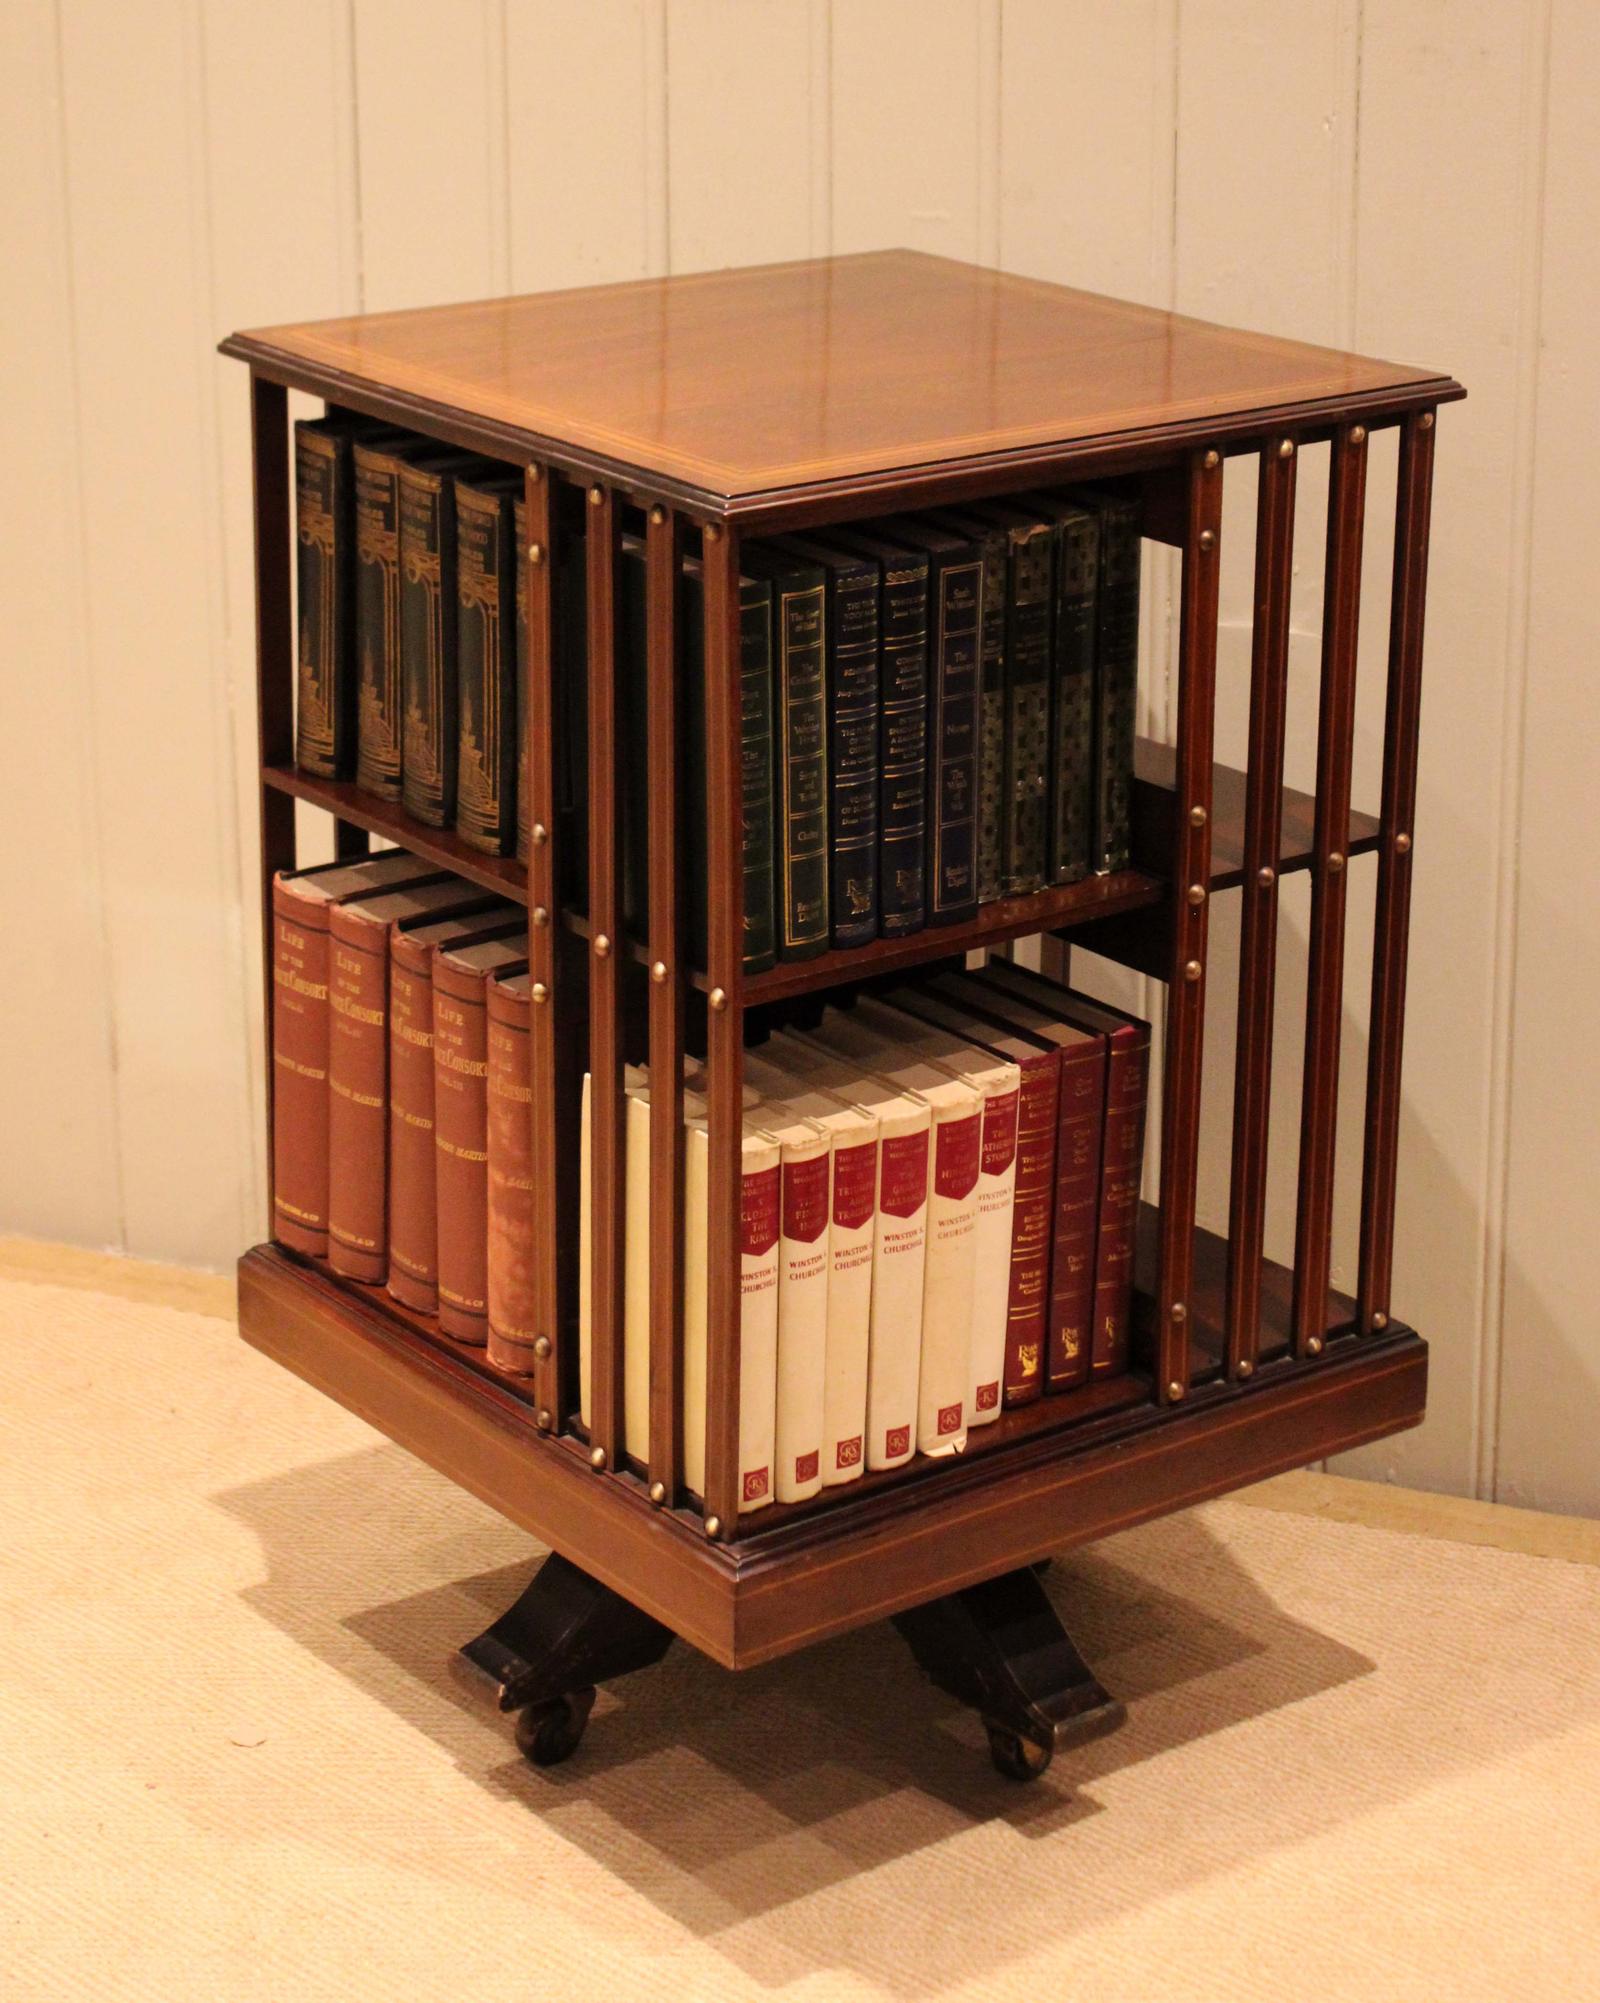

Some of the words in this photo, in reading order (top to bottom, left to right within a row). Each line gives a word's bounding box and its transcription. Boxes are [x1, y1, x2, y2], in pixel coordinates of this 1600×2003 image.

[281, 926, 305, 950] LIFE
[337, 951, 362, 976] LIFE
[289, 970, 328, 1000] CONSORT
[344, 996, 384, 1026] CONSORT
[438, 1001, 464, 1027] LIFE
[497, 1074, 533, 1104] CONSOR
[884, 1230, 917, 1243] WINSTON
[789, 1255, 823, 1269] WINSTON
[834, 1244, 869, 1259] WINSTON
